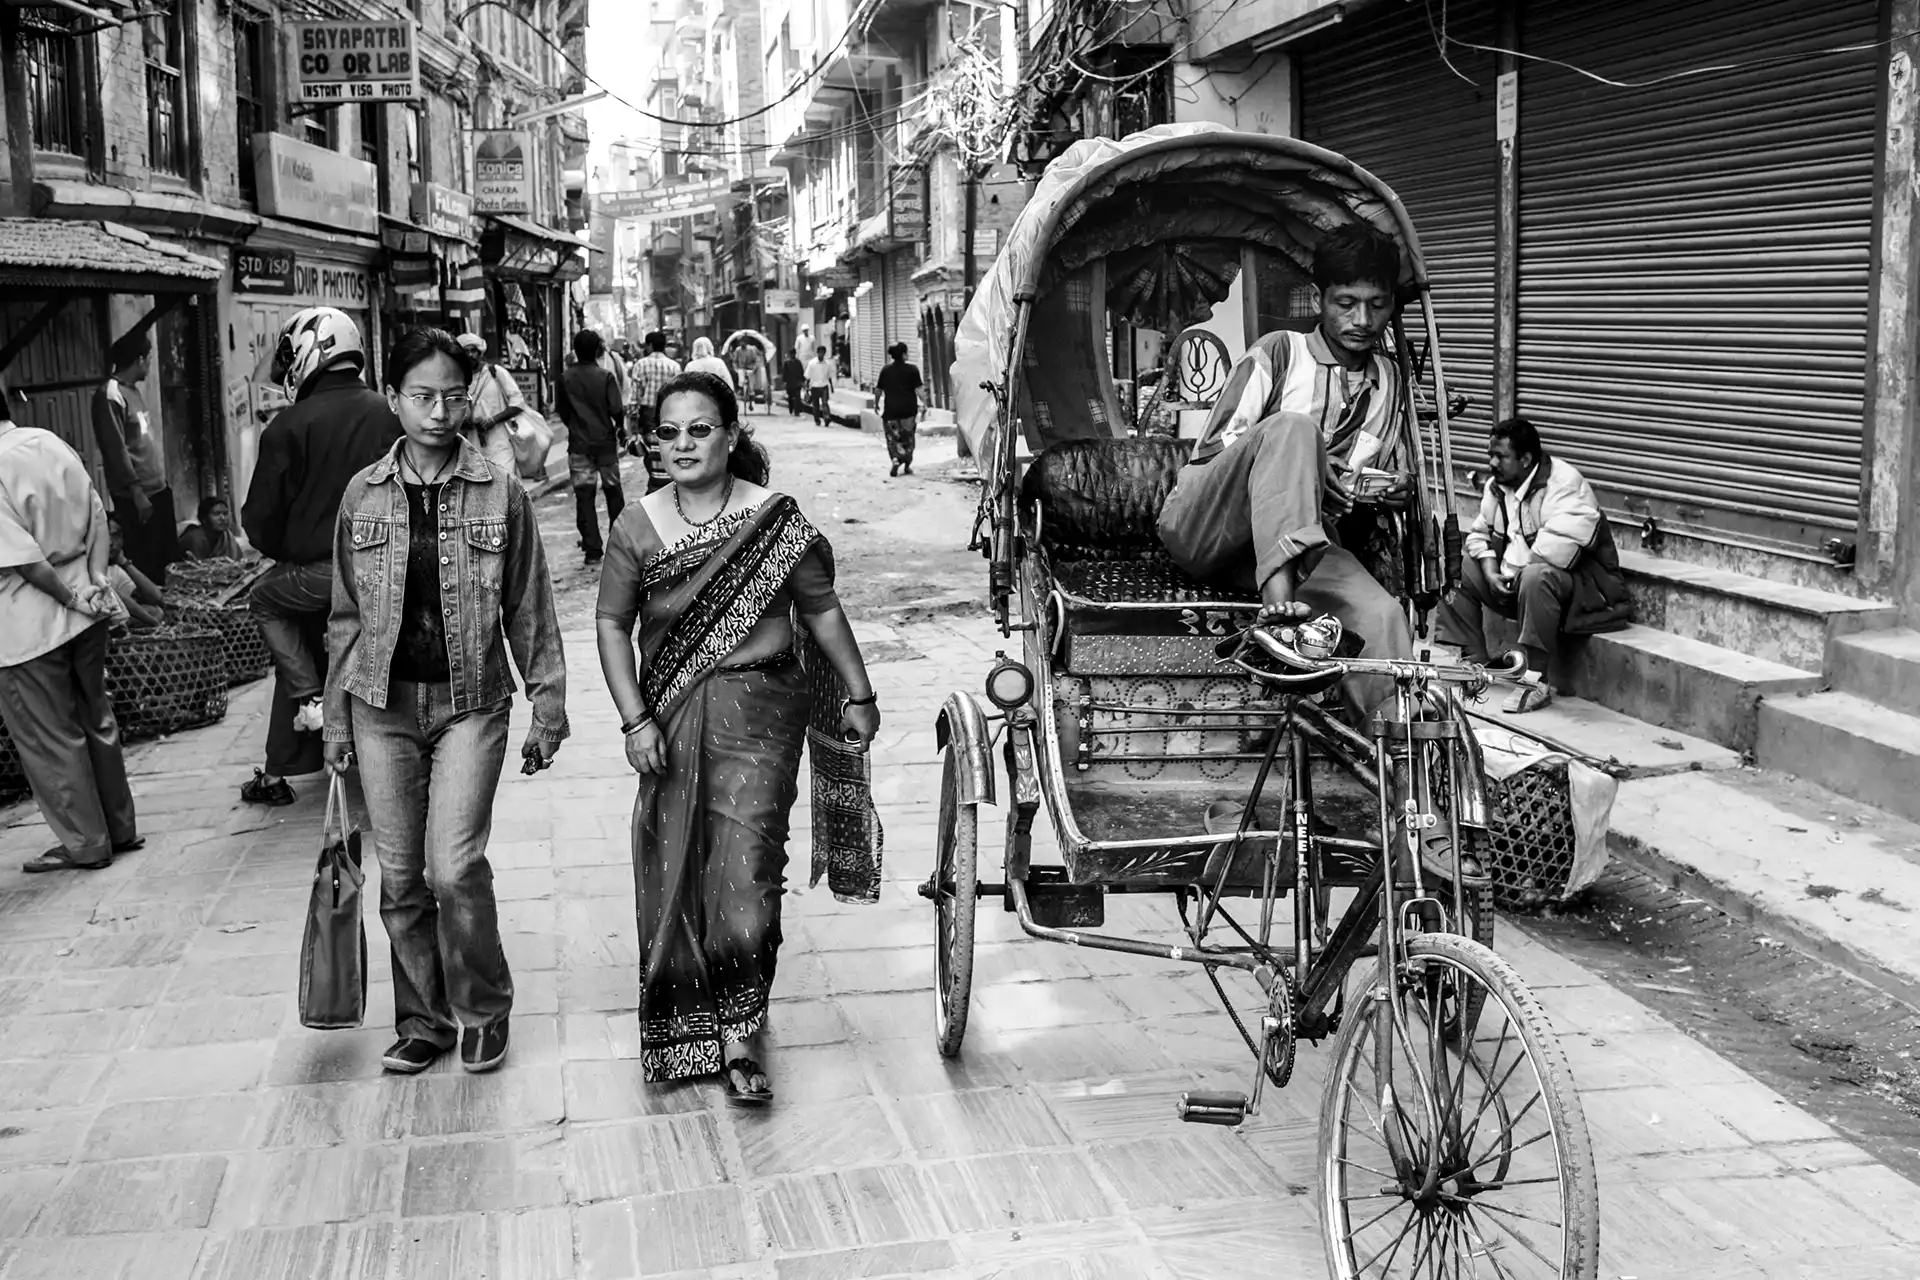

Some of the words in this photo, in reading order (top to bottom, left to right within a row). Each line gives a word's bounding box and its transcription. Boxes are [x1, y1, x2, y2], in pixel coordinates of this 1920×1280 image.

[303, 27, 406, 50] SAYAPATRI
[376, 52, 410, 74] LAB
[303, 84, 342, 98] INSTANT
[350, 83, 373, 97] VISA
[382, 83, 412, 97] PHOTO
[477, 161, 523, 175] Konica
[238, 255, 290, 275] STD/ISD
[322, 269, 365, 301] PHOTOS
